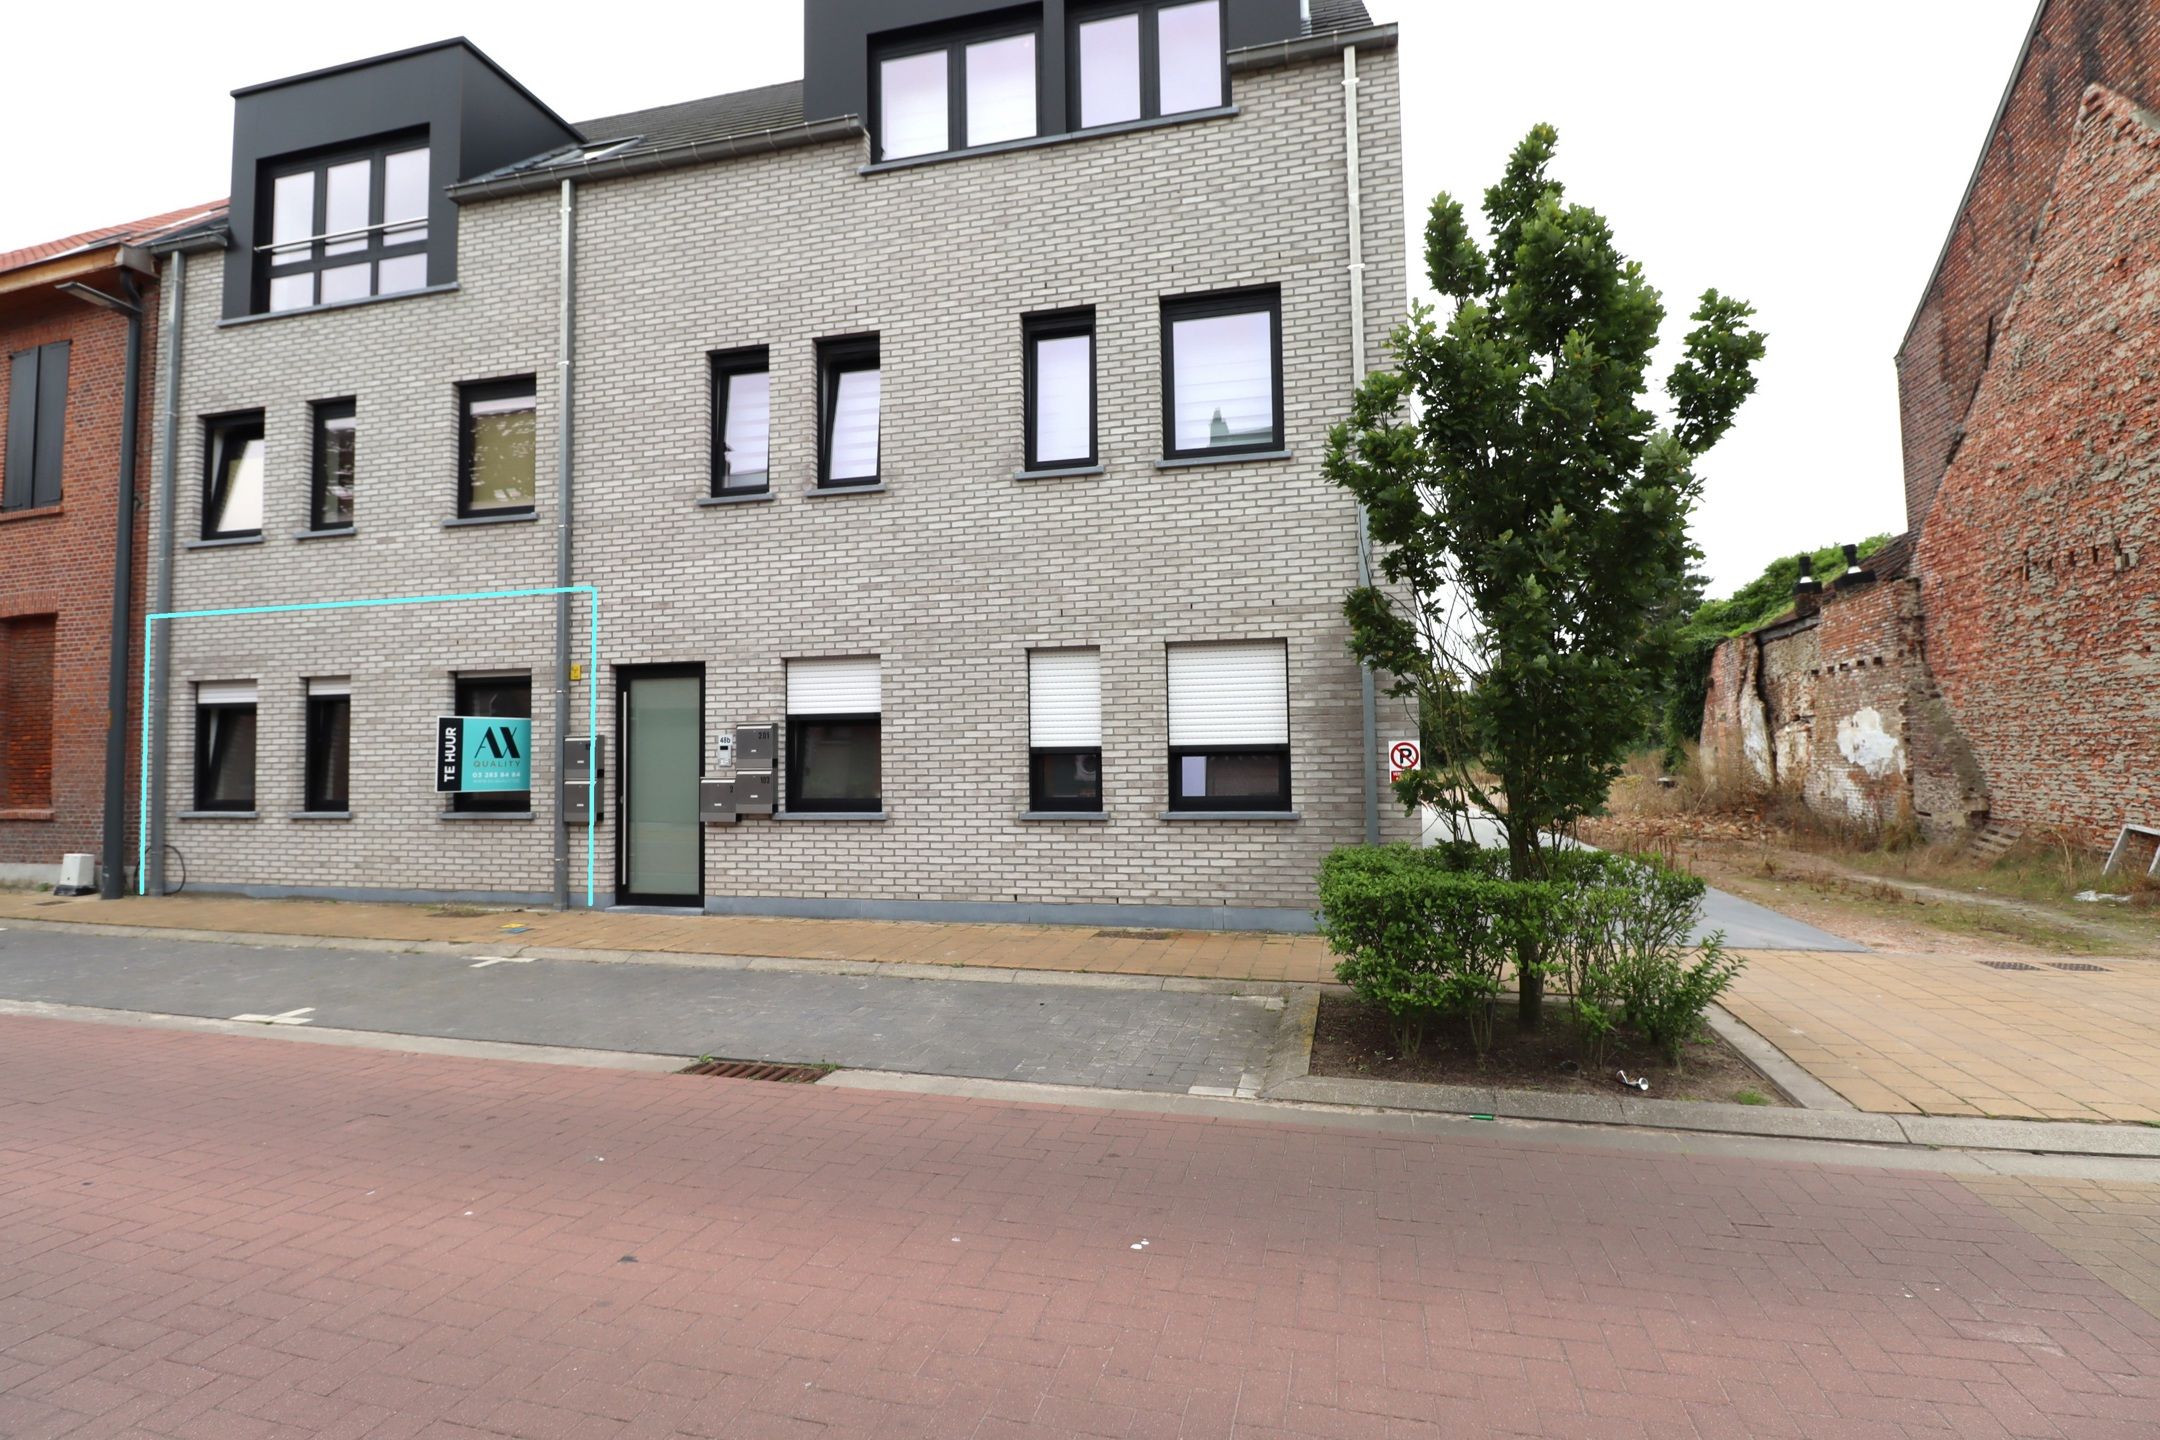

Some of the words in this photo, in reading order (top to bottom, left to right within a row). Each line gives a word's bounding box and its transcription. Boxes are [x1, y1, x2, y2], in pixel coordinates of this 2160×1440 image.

[444, 727, 457, 762] HUUR
[474, 726, 521, 759] AX
[719, 736, 731, 744] 48b
[473, 760, 521, 768] QUALITY
[443, 765, 456, 783] TE
